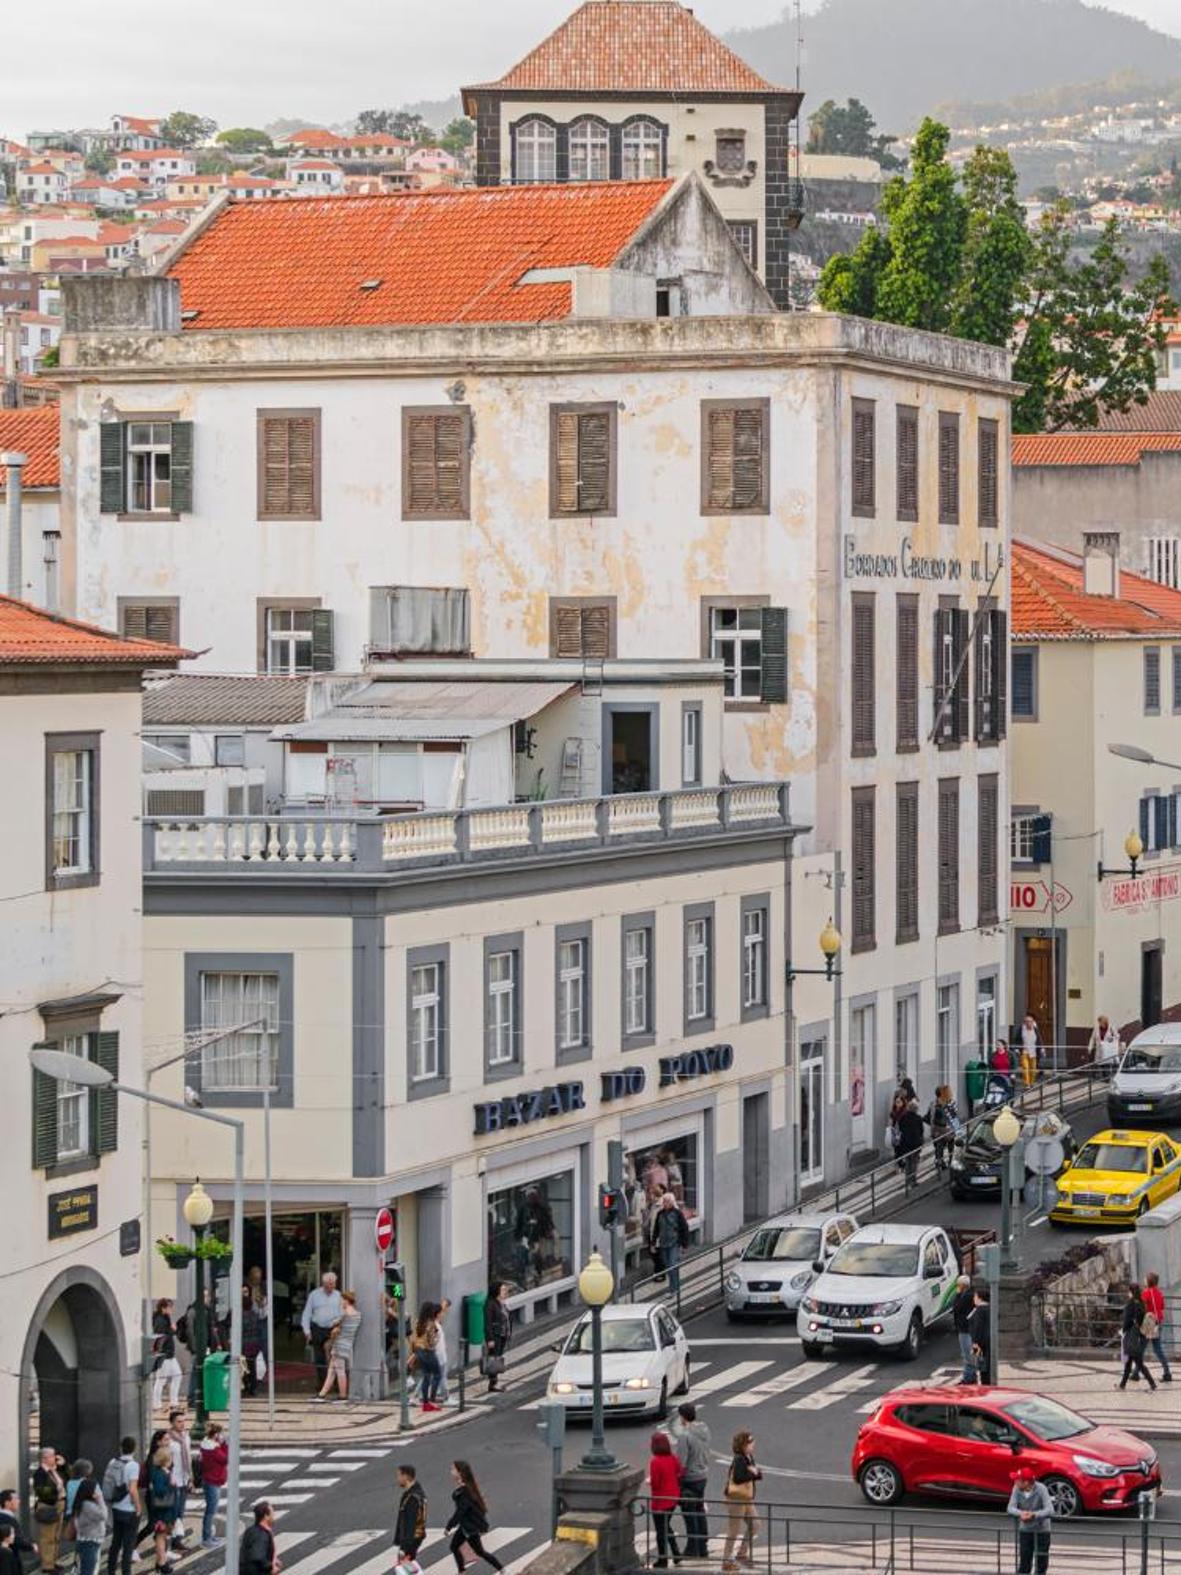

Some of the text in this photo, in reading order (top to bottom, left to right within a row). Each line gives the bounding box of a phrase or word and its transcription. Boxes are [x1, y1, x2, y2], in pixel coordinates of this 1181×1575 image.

[474, 1044, 734, 1135] BAZAR DO POVO
